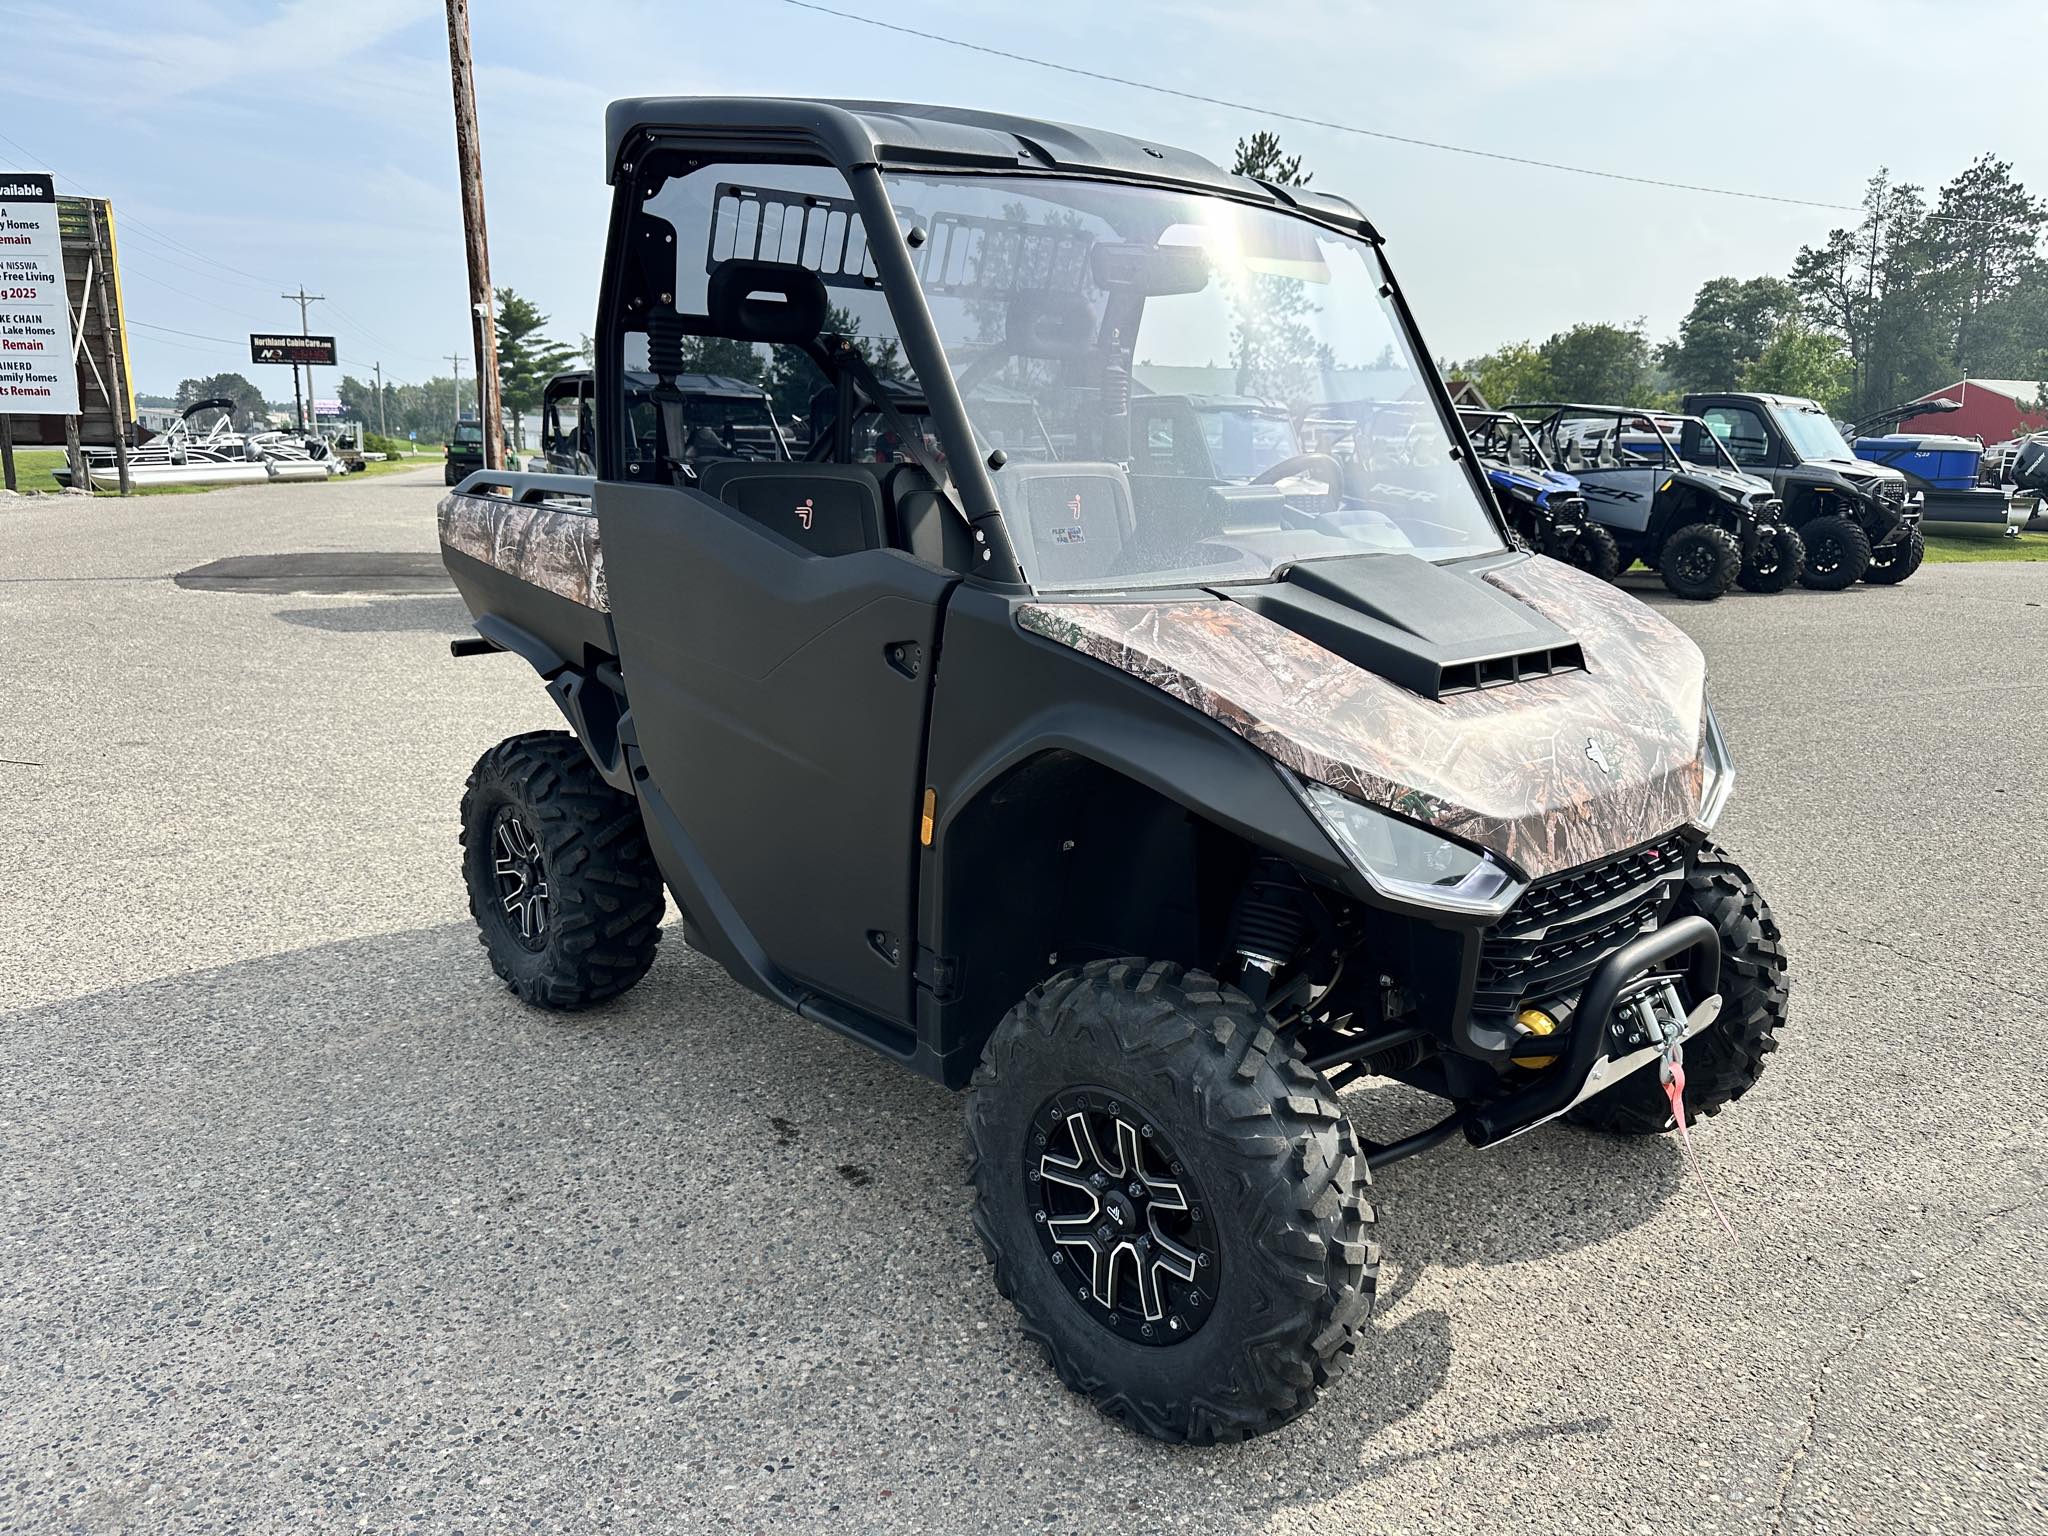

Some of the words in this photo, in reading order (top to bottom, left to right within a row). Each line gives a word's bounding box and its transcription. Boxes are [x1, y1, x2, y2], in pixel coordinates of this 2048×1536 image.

[7, 219, 40, 230] Homes
[6, 261, 38, 270] NISSWA
[3, 271, 24, 281] Free
[25, 271, 55, 284] Living
[9, 287, 37, 299] 2025
[13, 314, 42, 324] CHAIN
[2, 325, 24, 335] Lake
[25, 326, 56, 336] Homes
[2, 339, 44, 351] Remain
[25, 373, 58, 383] Homes
[10, 386, 51, 397] Remain
